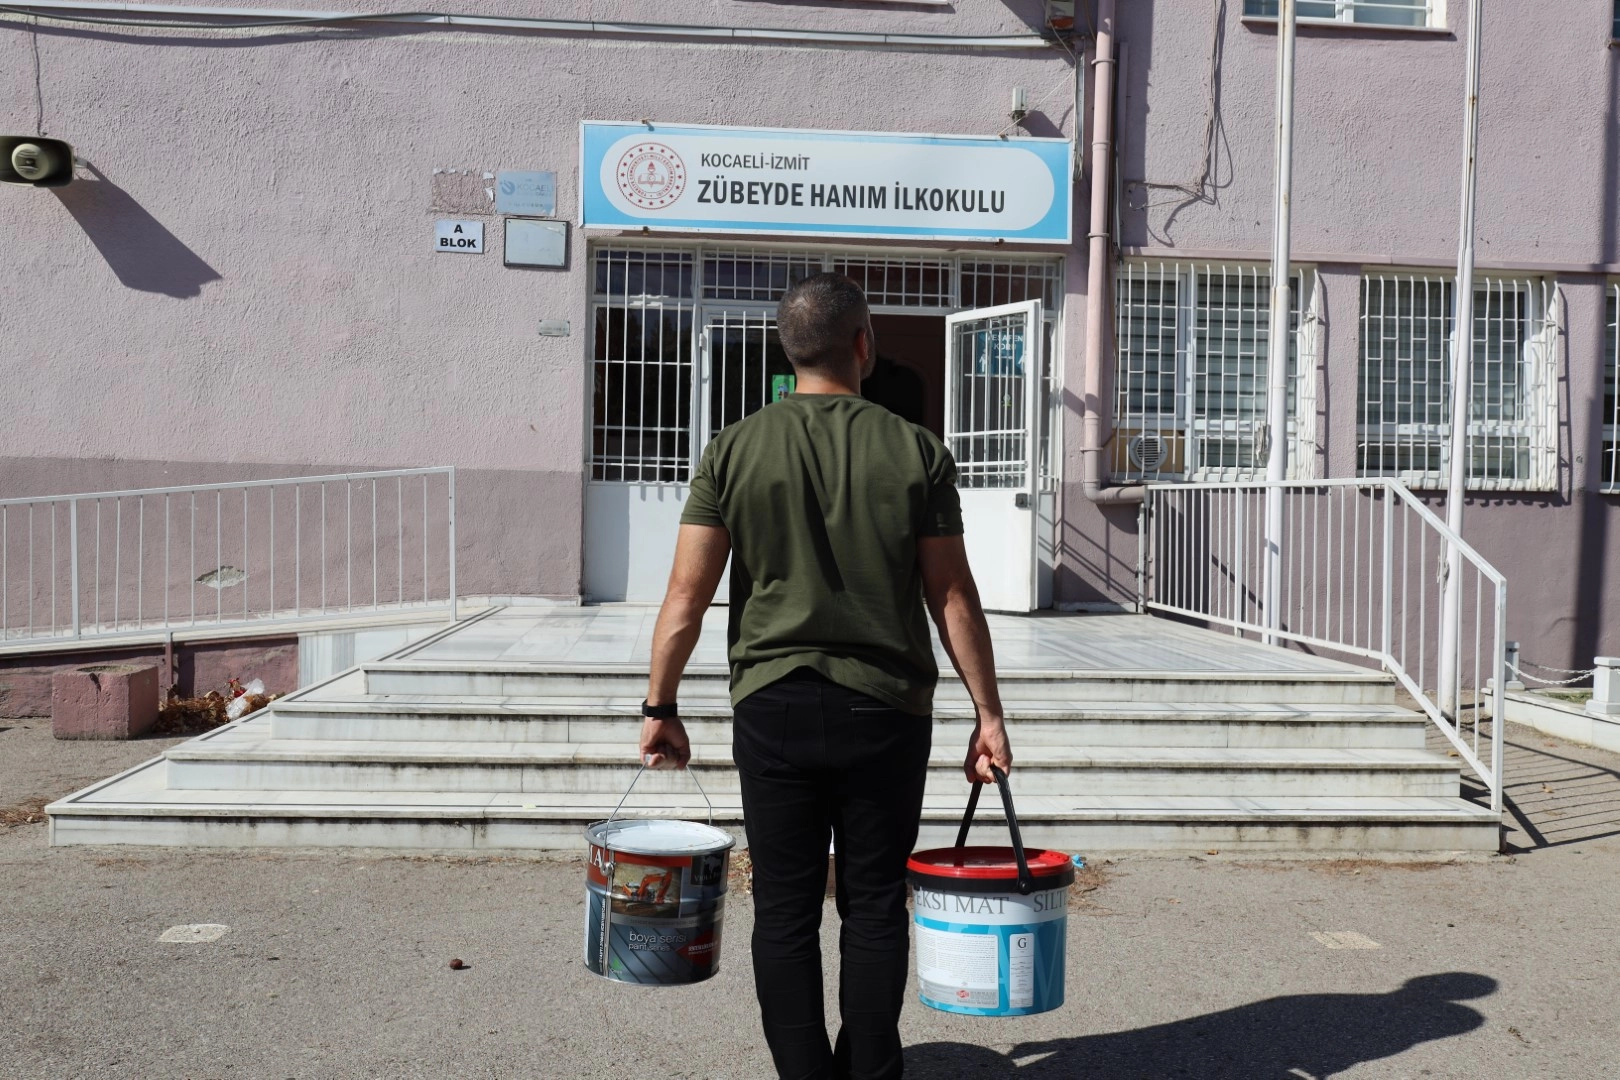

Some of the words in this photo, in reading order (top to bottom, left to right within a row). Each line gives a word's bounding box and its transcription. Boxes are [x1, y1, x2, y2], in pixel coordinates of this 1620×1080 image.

[701, 152, 810, 171] KOCAELİ-İZMİT
[697, 175, 804, 206] ZÜBEYDE
[810, 183, 887, 209] HANIM
[894, 181, 1005, 213] İLKOKULU
[454, 224, 463, 233] A
[440, 237, 477, 248] BLOK
[955, 895, 1010, 915] MAT
[629, 931, 656, 943] boya
[1017, 937, 1028, 949] G
